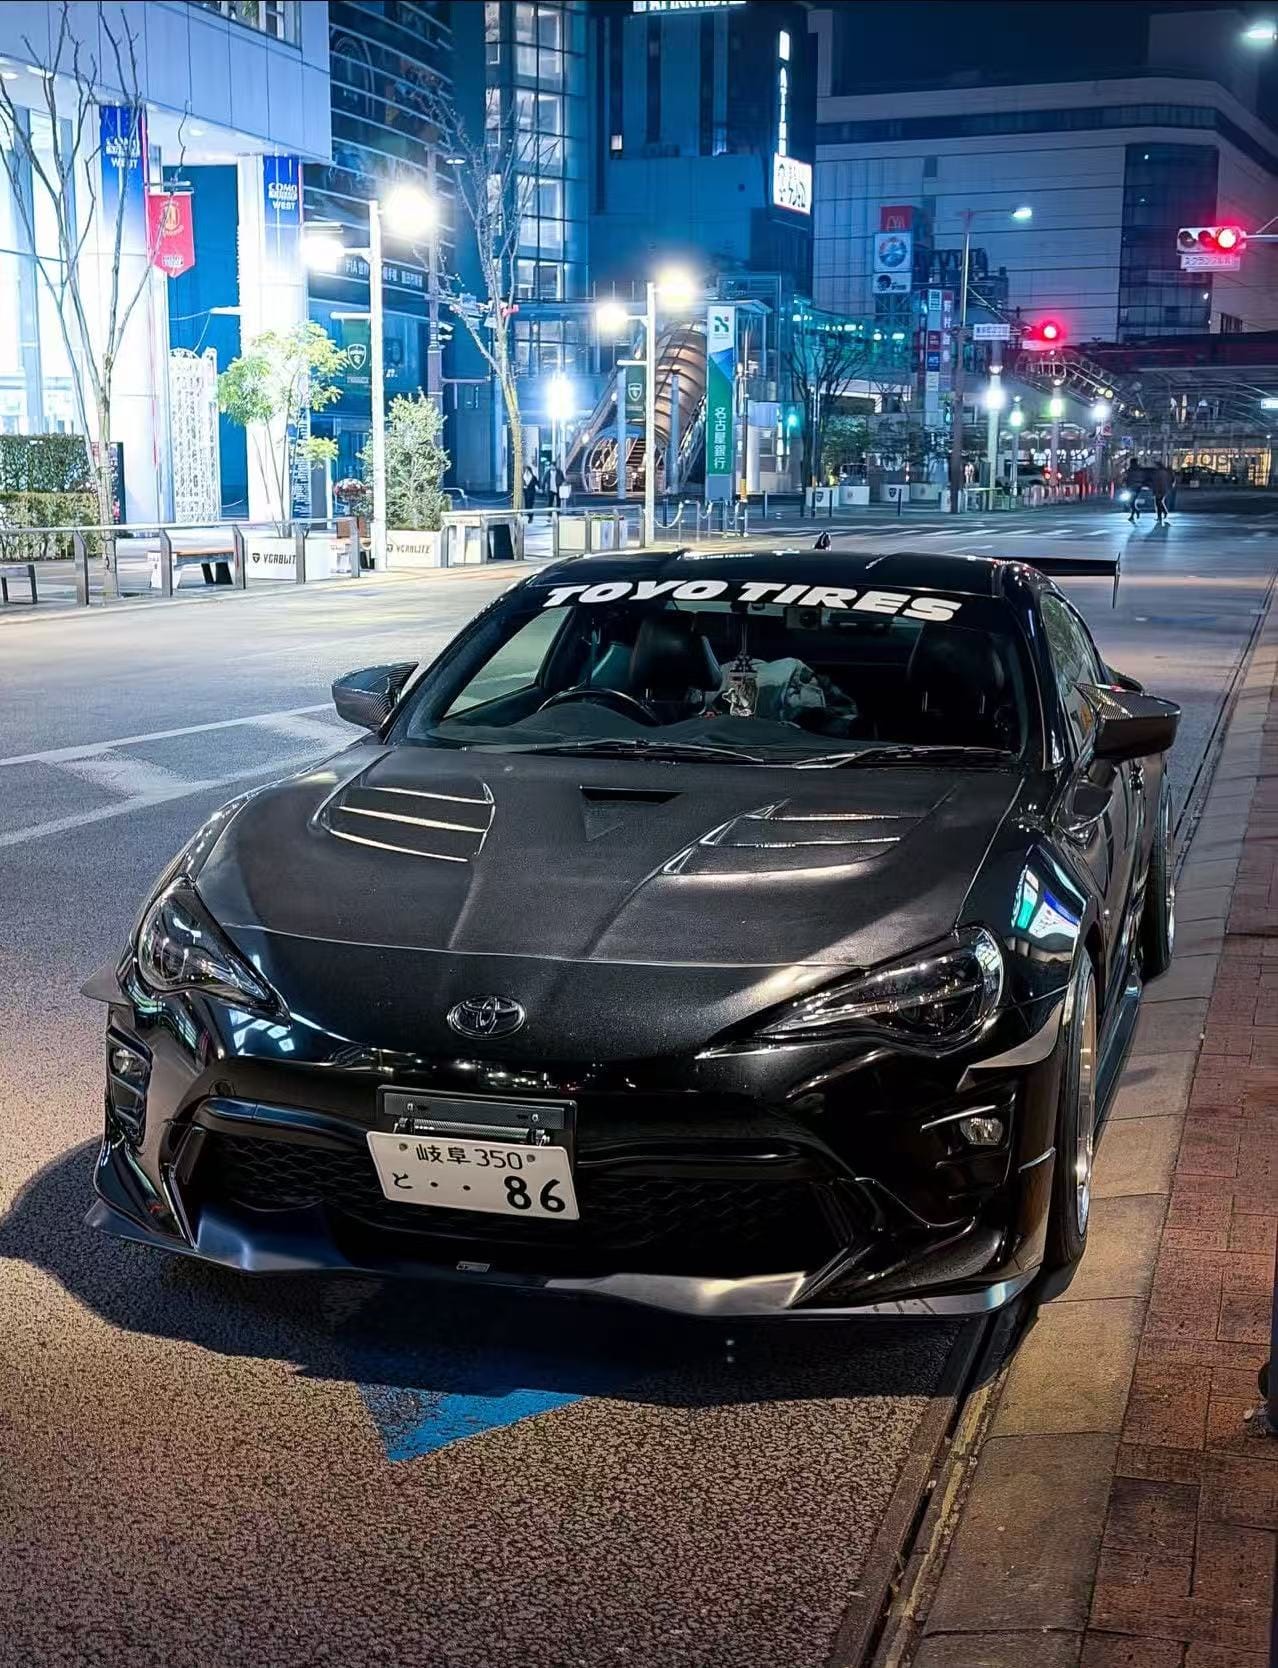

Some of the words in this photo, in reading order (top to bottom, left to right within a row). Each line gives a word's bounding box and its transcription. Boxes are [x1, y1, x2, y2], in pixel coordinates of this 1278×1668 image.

[541, 580, 729, 608] TOYO
[739, 581, 962, 621] TIRES
[504, 1175, 566, 1212] 86
